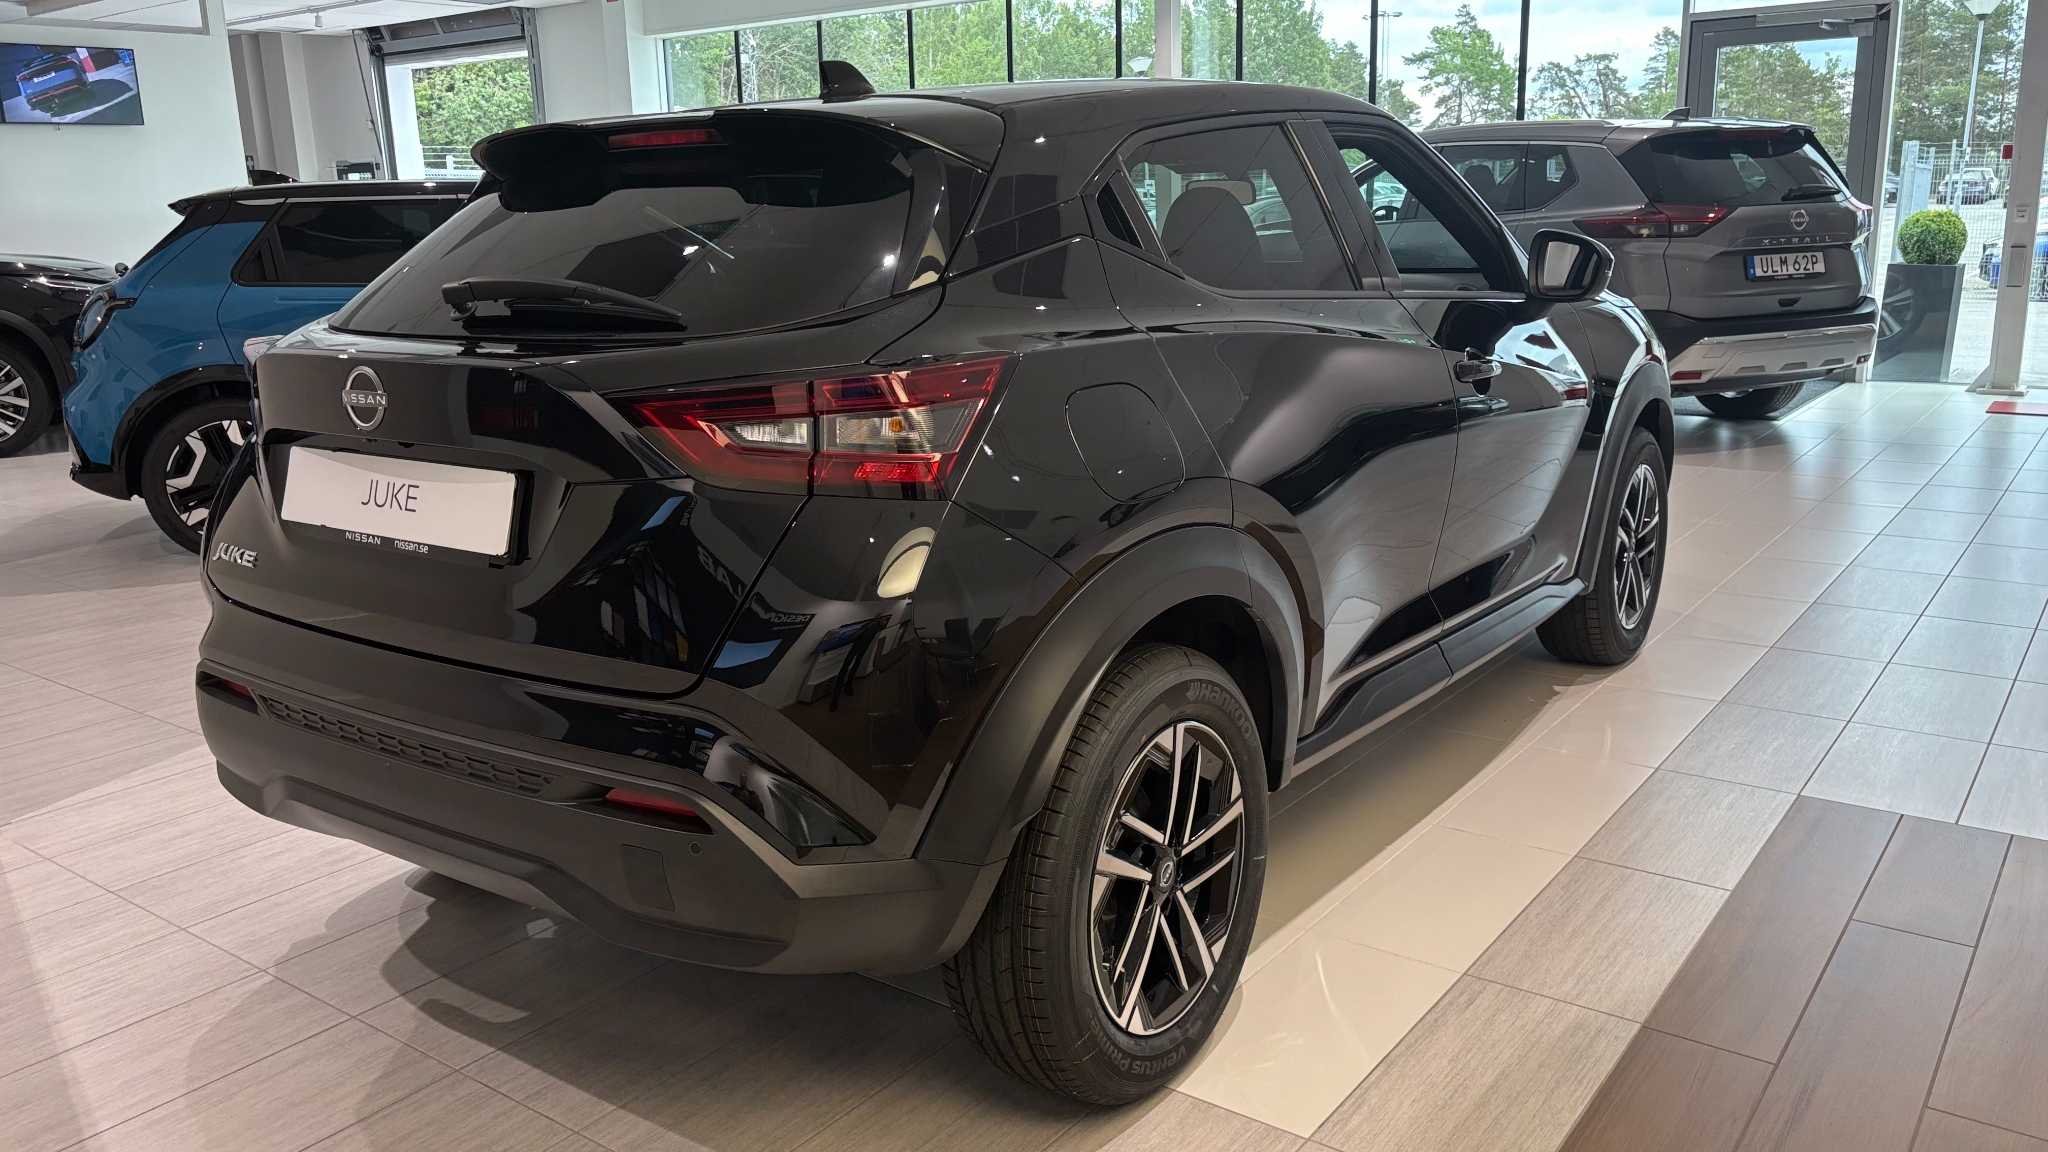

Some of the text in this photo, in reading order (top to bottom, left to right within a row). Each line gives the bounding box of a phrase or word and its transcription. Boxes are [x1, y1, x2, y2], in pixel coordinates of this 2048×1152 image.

[1762, 235, 1832, 246] X-TRAIL
[1760, 254, 1818, 273] ULM 62P
[342, 392, 386, 405] NISSAN
[361, 479, 419, 512] JUKE
[345, 531, 429, 554] NISSAN nissan.se
[212, 542, 258, 568] JUKE
